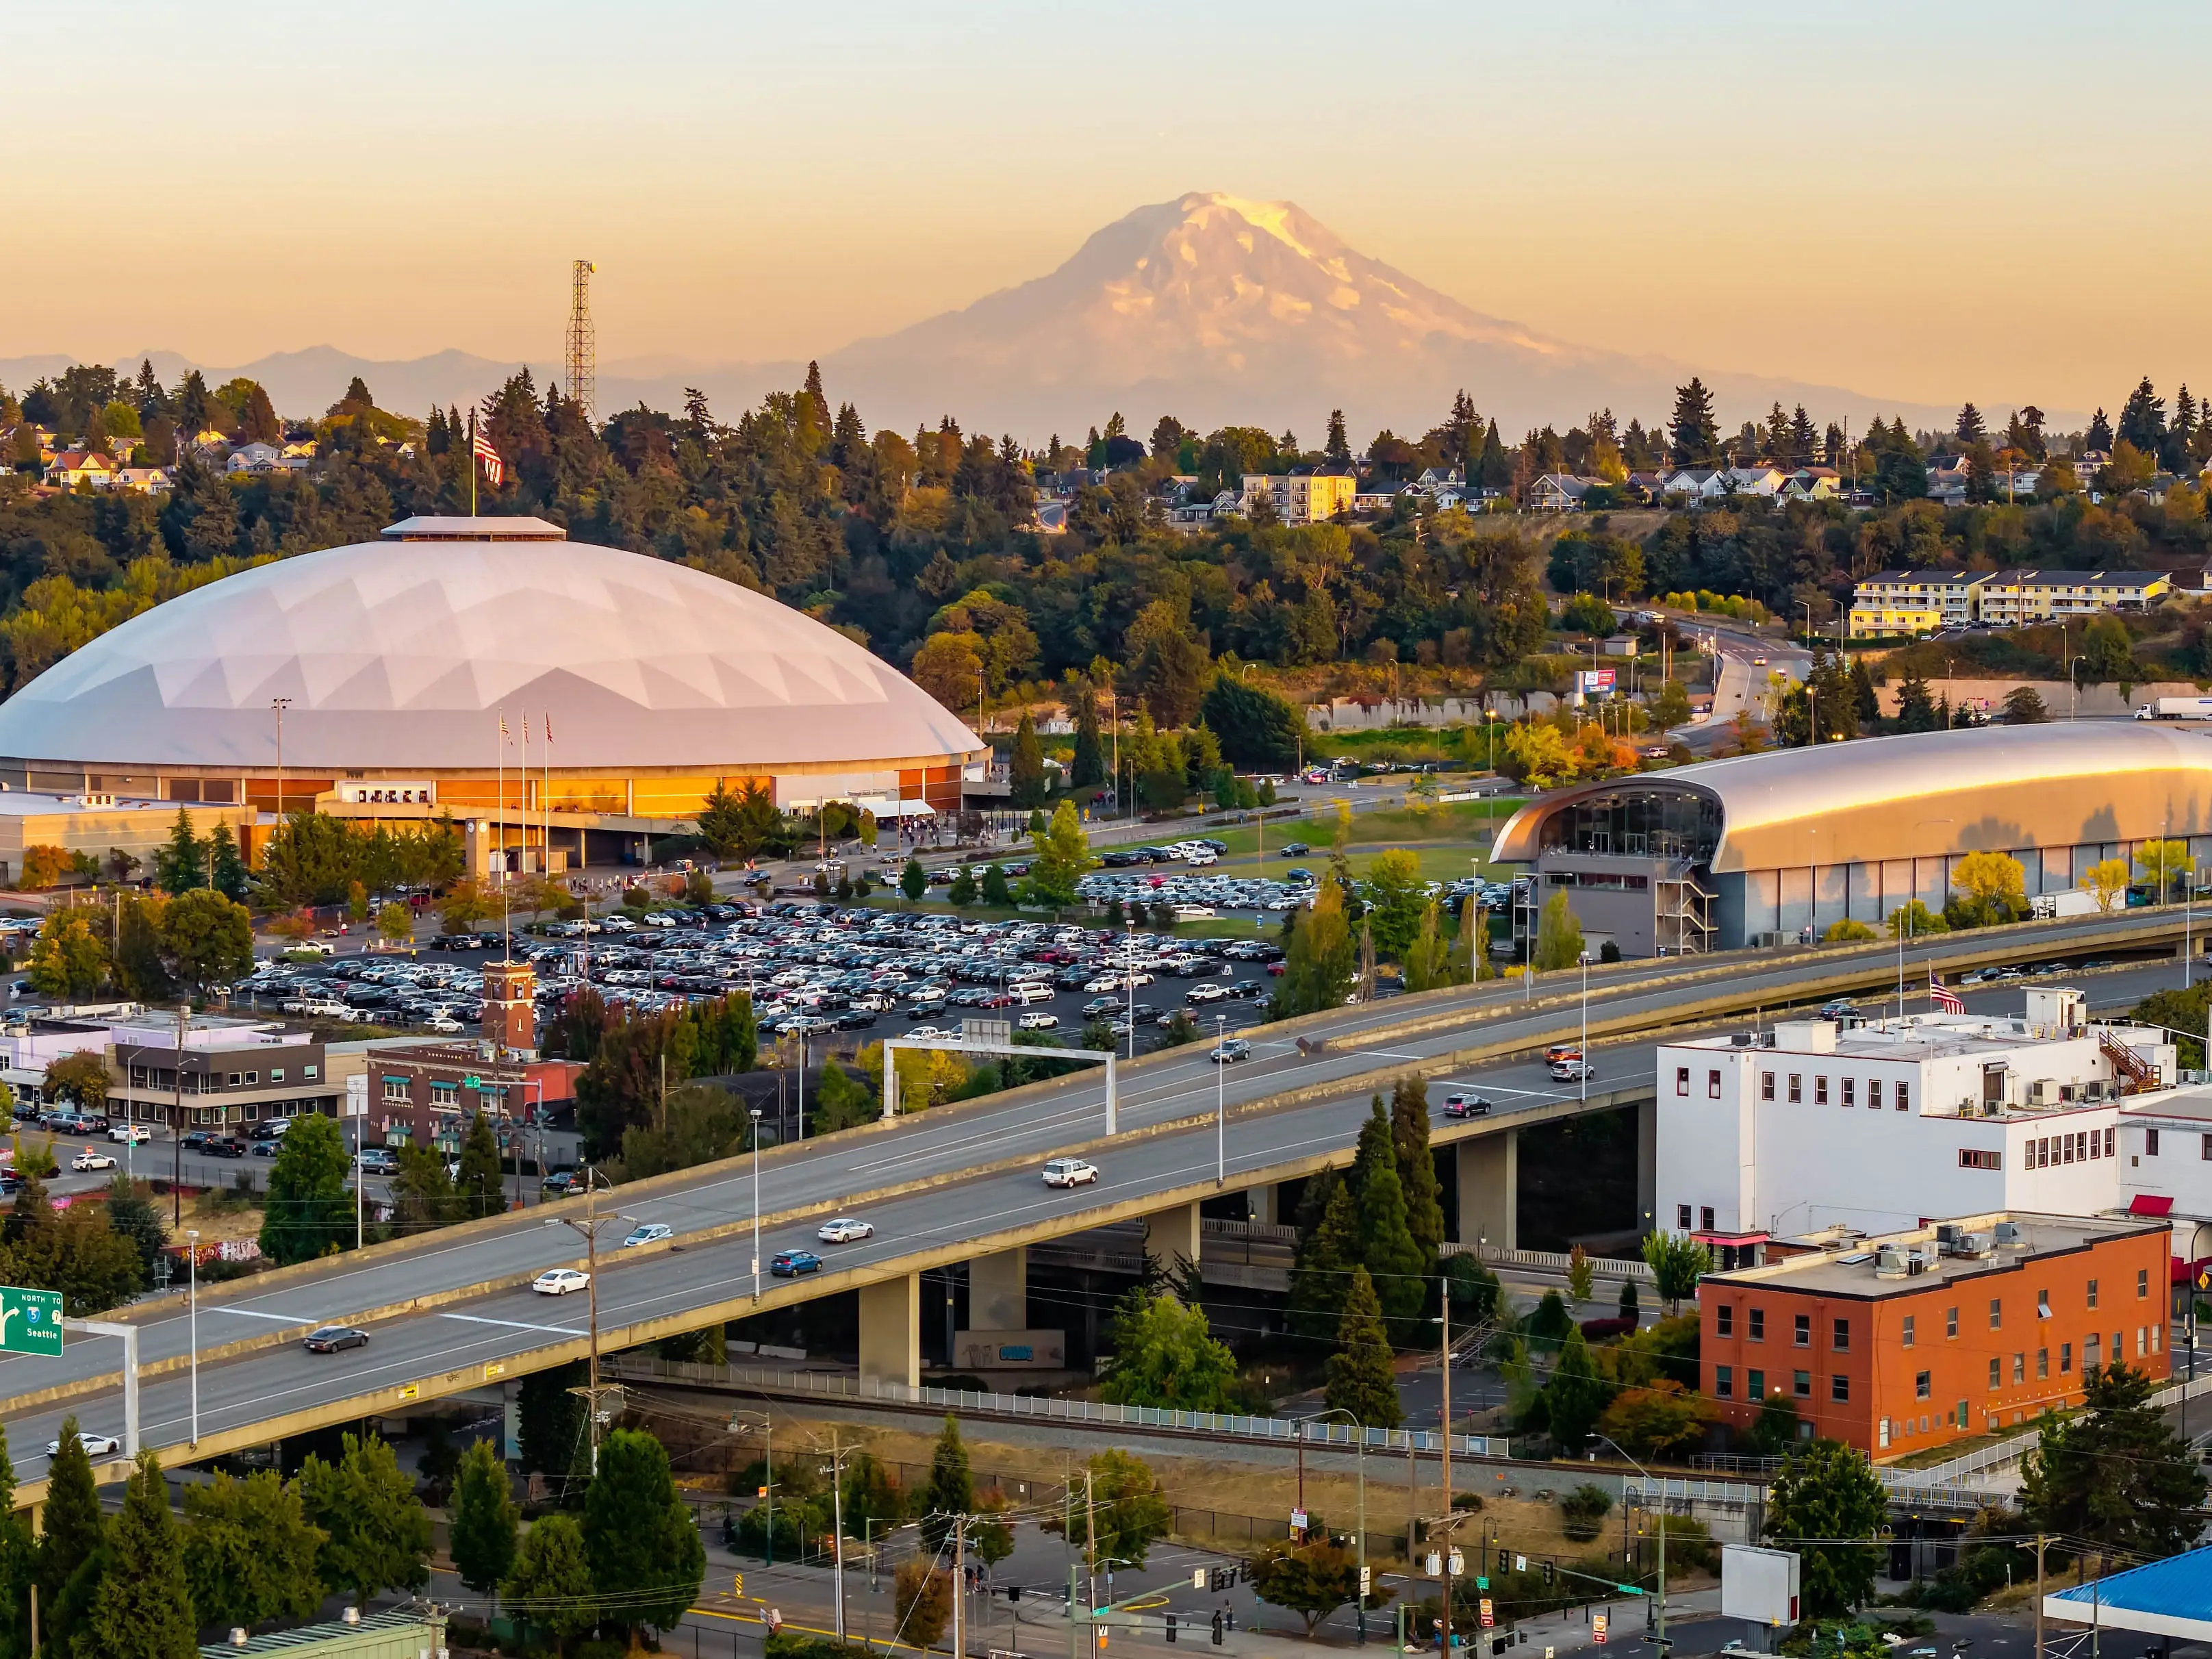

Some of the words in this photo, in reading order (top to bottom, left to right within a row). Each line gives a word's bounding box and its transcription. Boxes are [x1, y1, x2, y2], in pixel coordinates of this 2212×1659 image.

[22, 1294, 45, 1302] NORTH
[31, 1310, 36, 1319] 5
[55, 1312, 59, 1320] 7
[27, 1328, 57, 1339] Seattle
